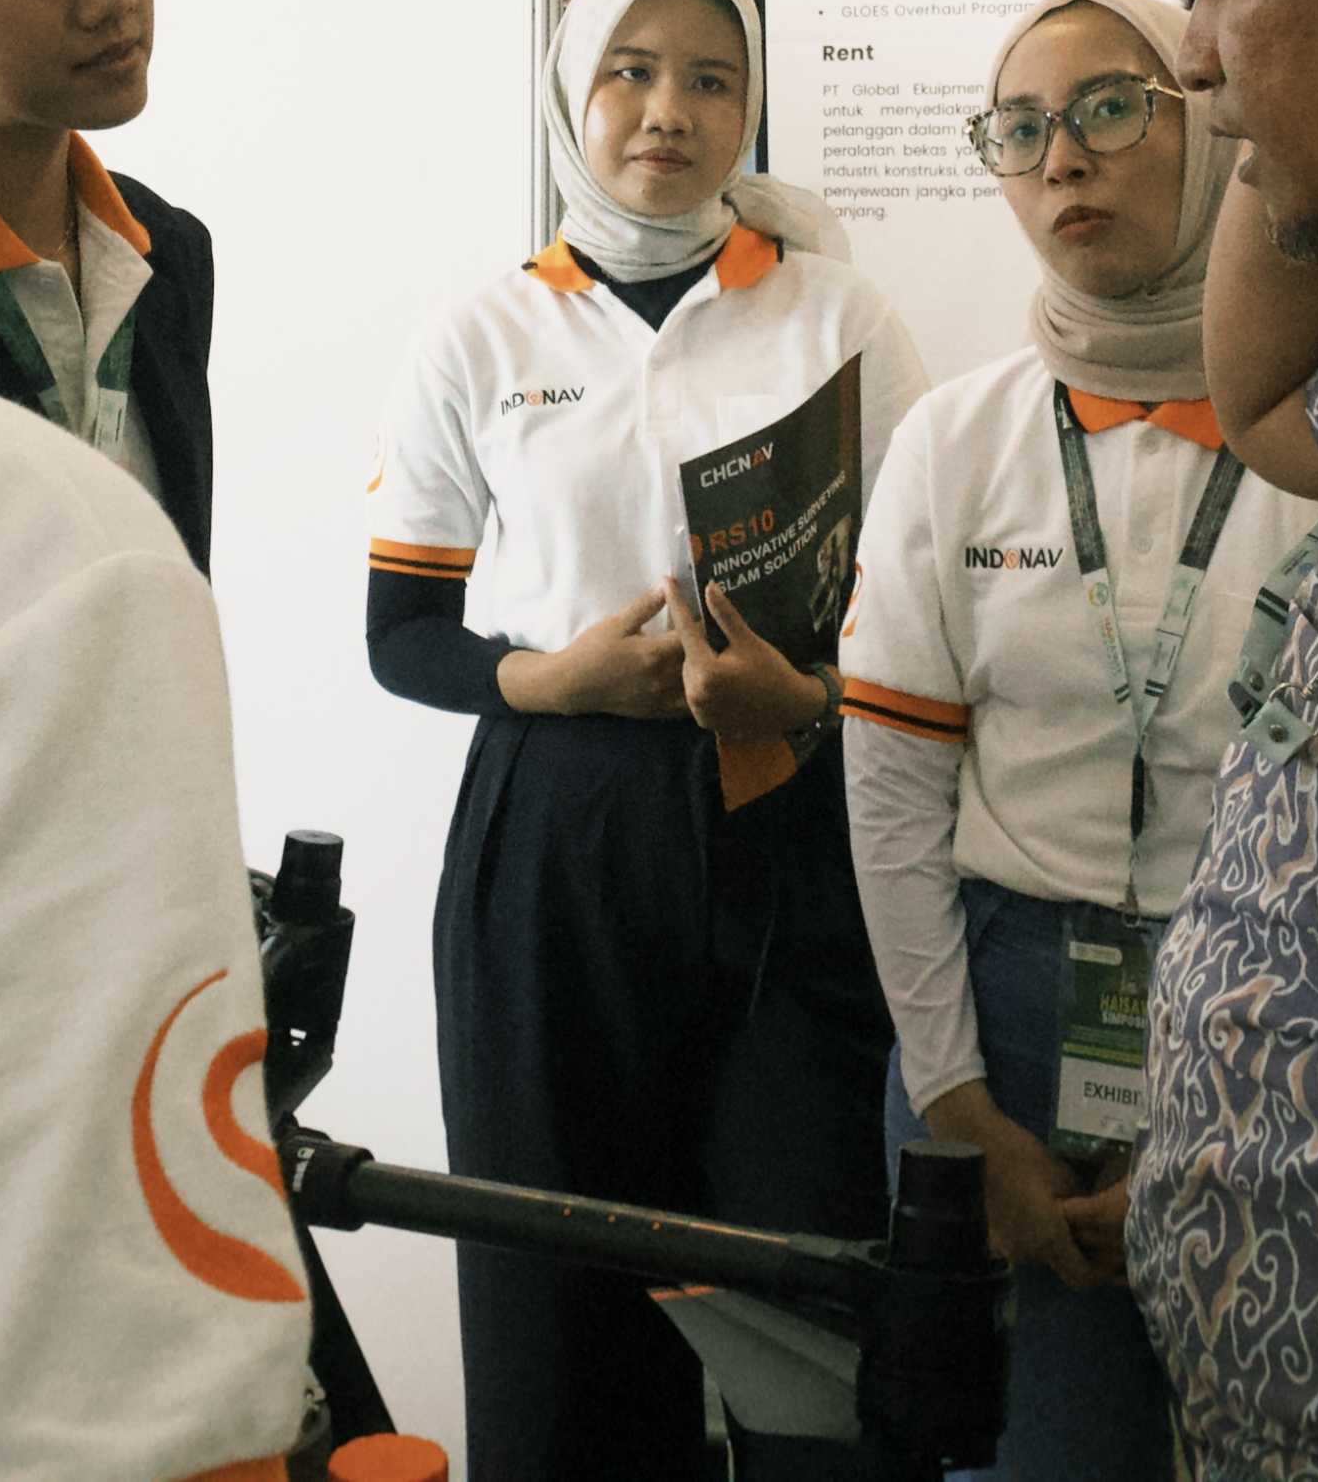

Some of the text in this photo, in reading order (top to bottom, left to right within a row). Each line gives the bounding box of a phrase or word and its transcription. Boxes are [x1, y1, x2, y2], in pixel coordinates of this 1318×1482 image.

[841, 5, 889, 19] GLOES
[894, 2, 966, 17] Overhaul
[823, 44, 875, 62] Rent
[823, 82, 985, 98] PT Global Ekuipmen
[823, 103, 982, 119] untuk menyediakan
[823, 124, 904, 140] pelanggan
[908, 123, 956, 136] dalam
[823, 144, 895, 160] peralatan
[902, 143, 948, 157] bekas
[823, 186, 909, 201] penyewaan
[915, 185, 966, 202] jangka
[500, 385, 585, 417] INDONAV
[700, 441, 774, 488] CHCNAV
[712, 470, 846, 576] INNOVATIVE SURVEYING
[764, 521, 818, 575] SOLUTION
[964, 547, 1063, 570] INDONAV
